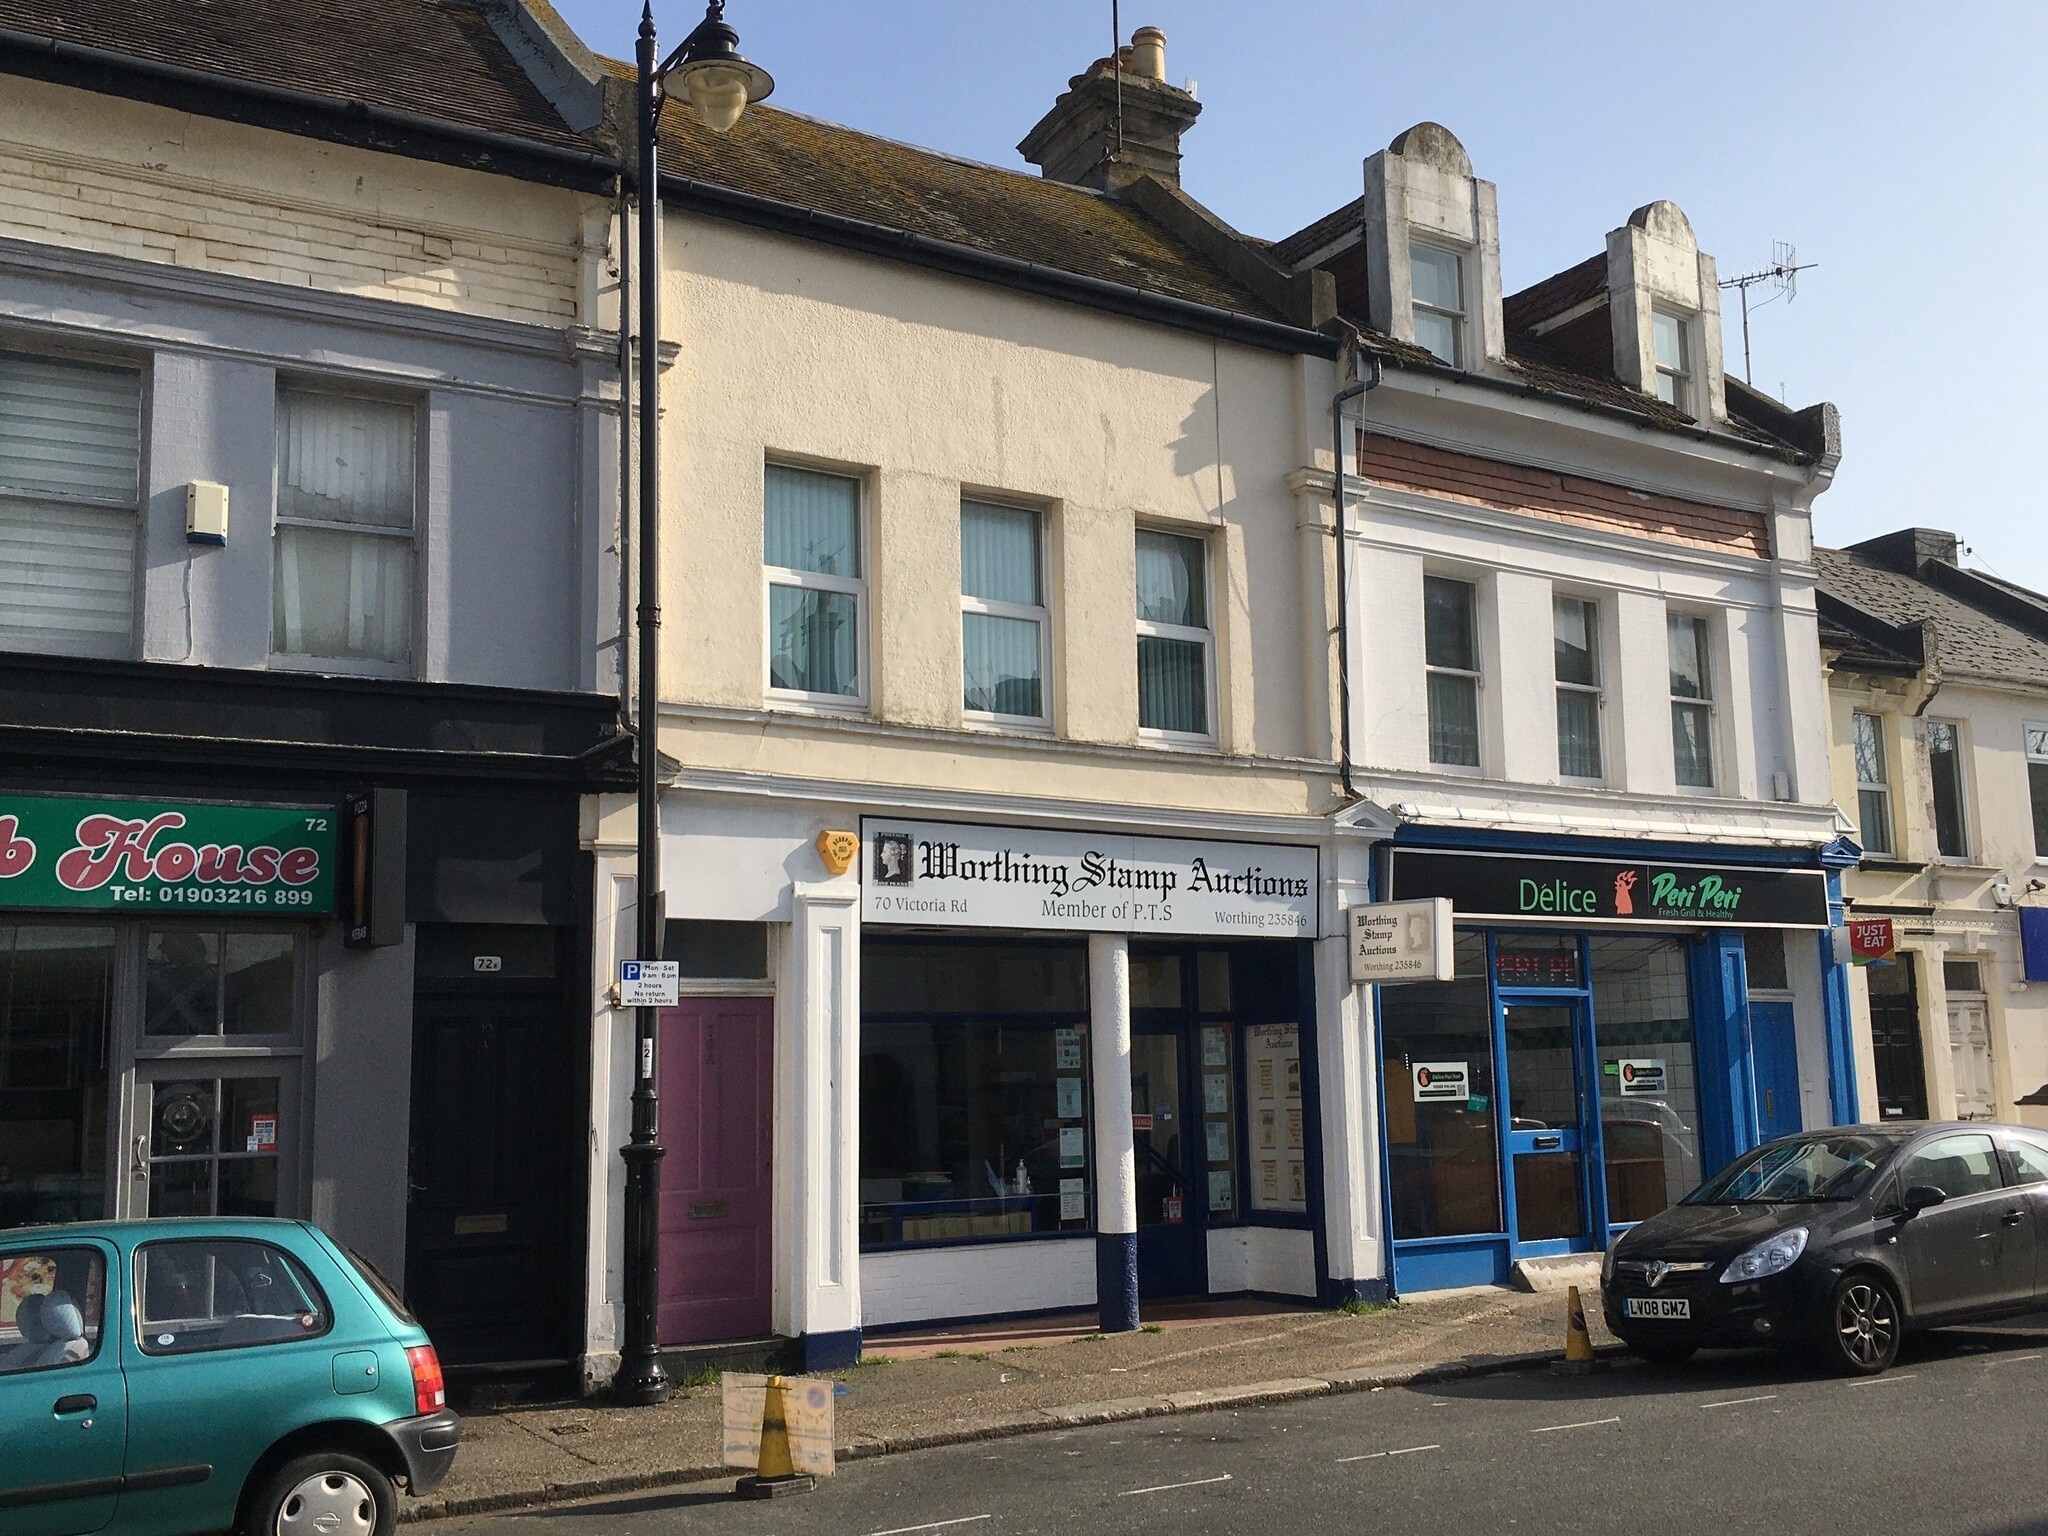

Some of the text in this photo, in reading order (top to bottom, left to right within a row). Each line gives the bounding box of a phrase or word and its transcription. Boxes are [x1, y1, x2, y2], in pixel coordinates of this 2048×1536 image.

[305, 818, 328, 832] 72
[56, 811, 320, 891] House
[918, 840, 1309, 903] Worthing Stamp Auctions
[110, 885, 313, 906] Tel: 01903216 899
[1519, 872, 1742, 913] Délice Peri Peri
[875, 896, 968, 913] 70 Victoria Rd
[1041, 899, 1173, 921] Member of P.T.S
[1215, 911, 1307, 928] Worthing 235846
[1658, 907, 1734, 920] Fresh Grill & Healthy
[1357, 915, 1398, 928] Worthing
[1362, 929, 1393, 942] Stamp
[1857, 924, 1886, 939] JUST
[1864, 936, 1887, 948] EAT
[1358, 944, 1397, 956] Auctions
[627, 964, 638, 979] P
[1364, 960, 1422, 973] Worthing 235846
[1630, 1300, 1687, 1316] LV08 GMZ
